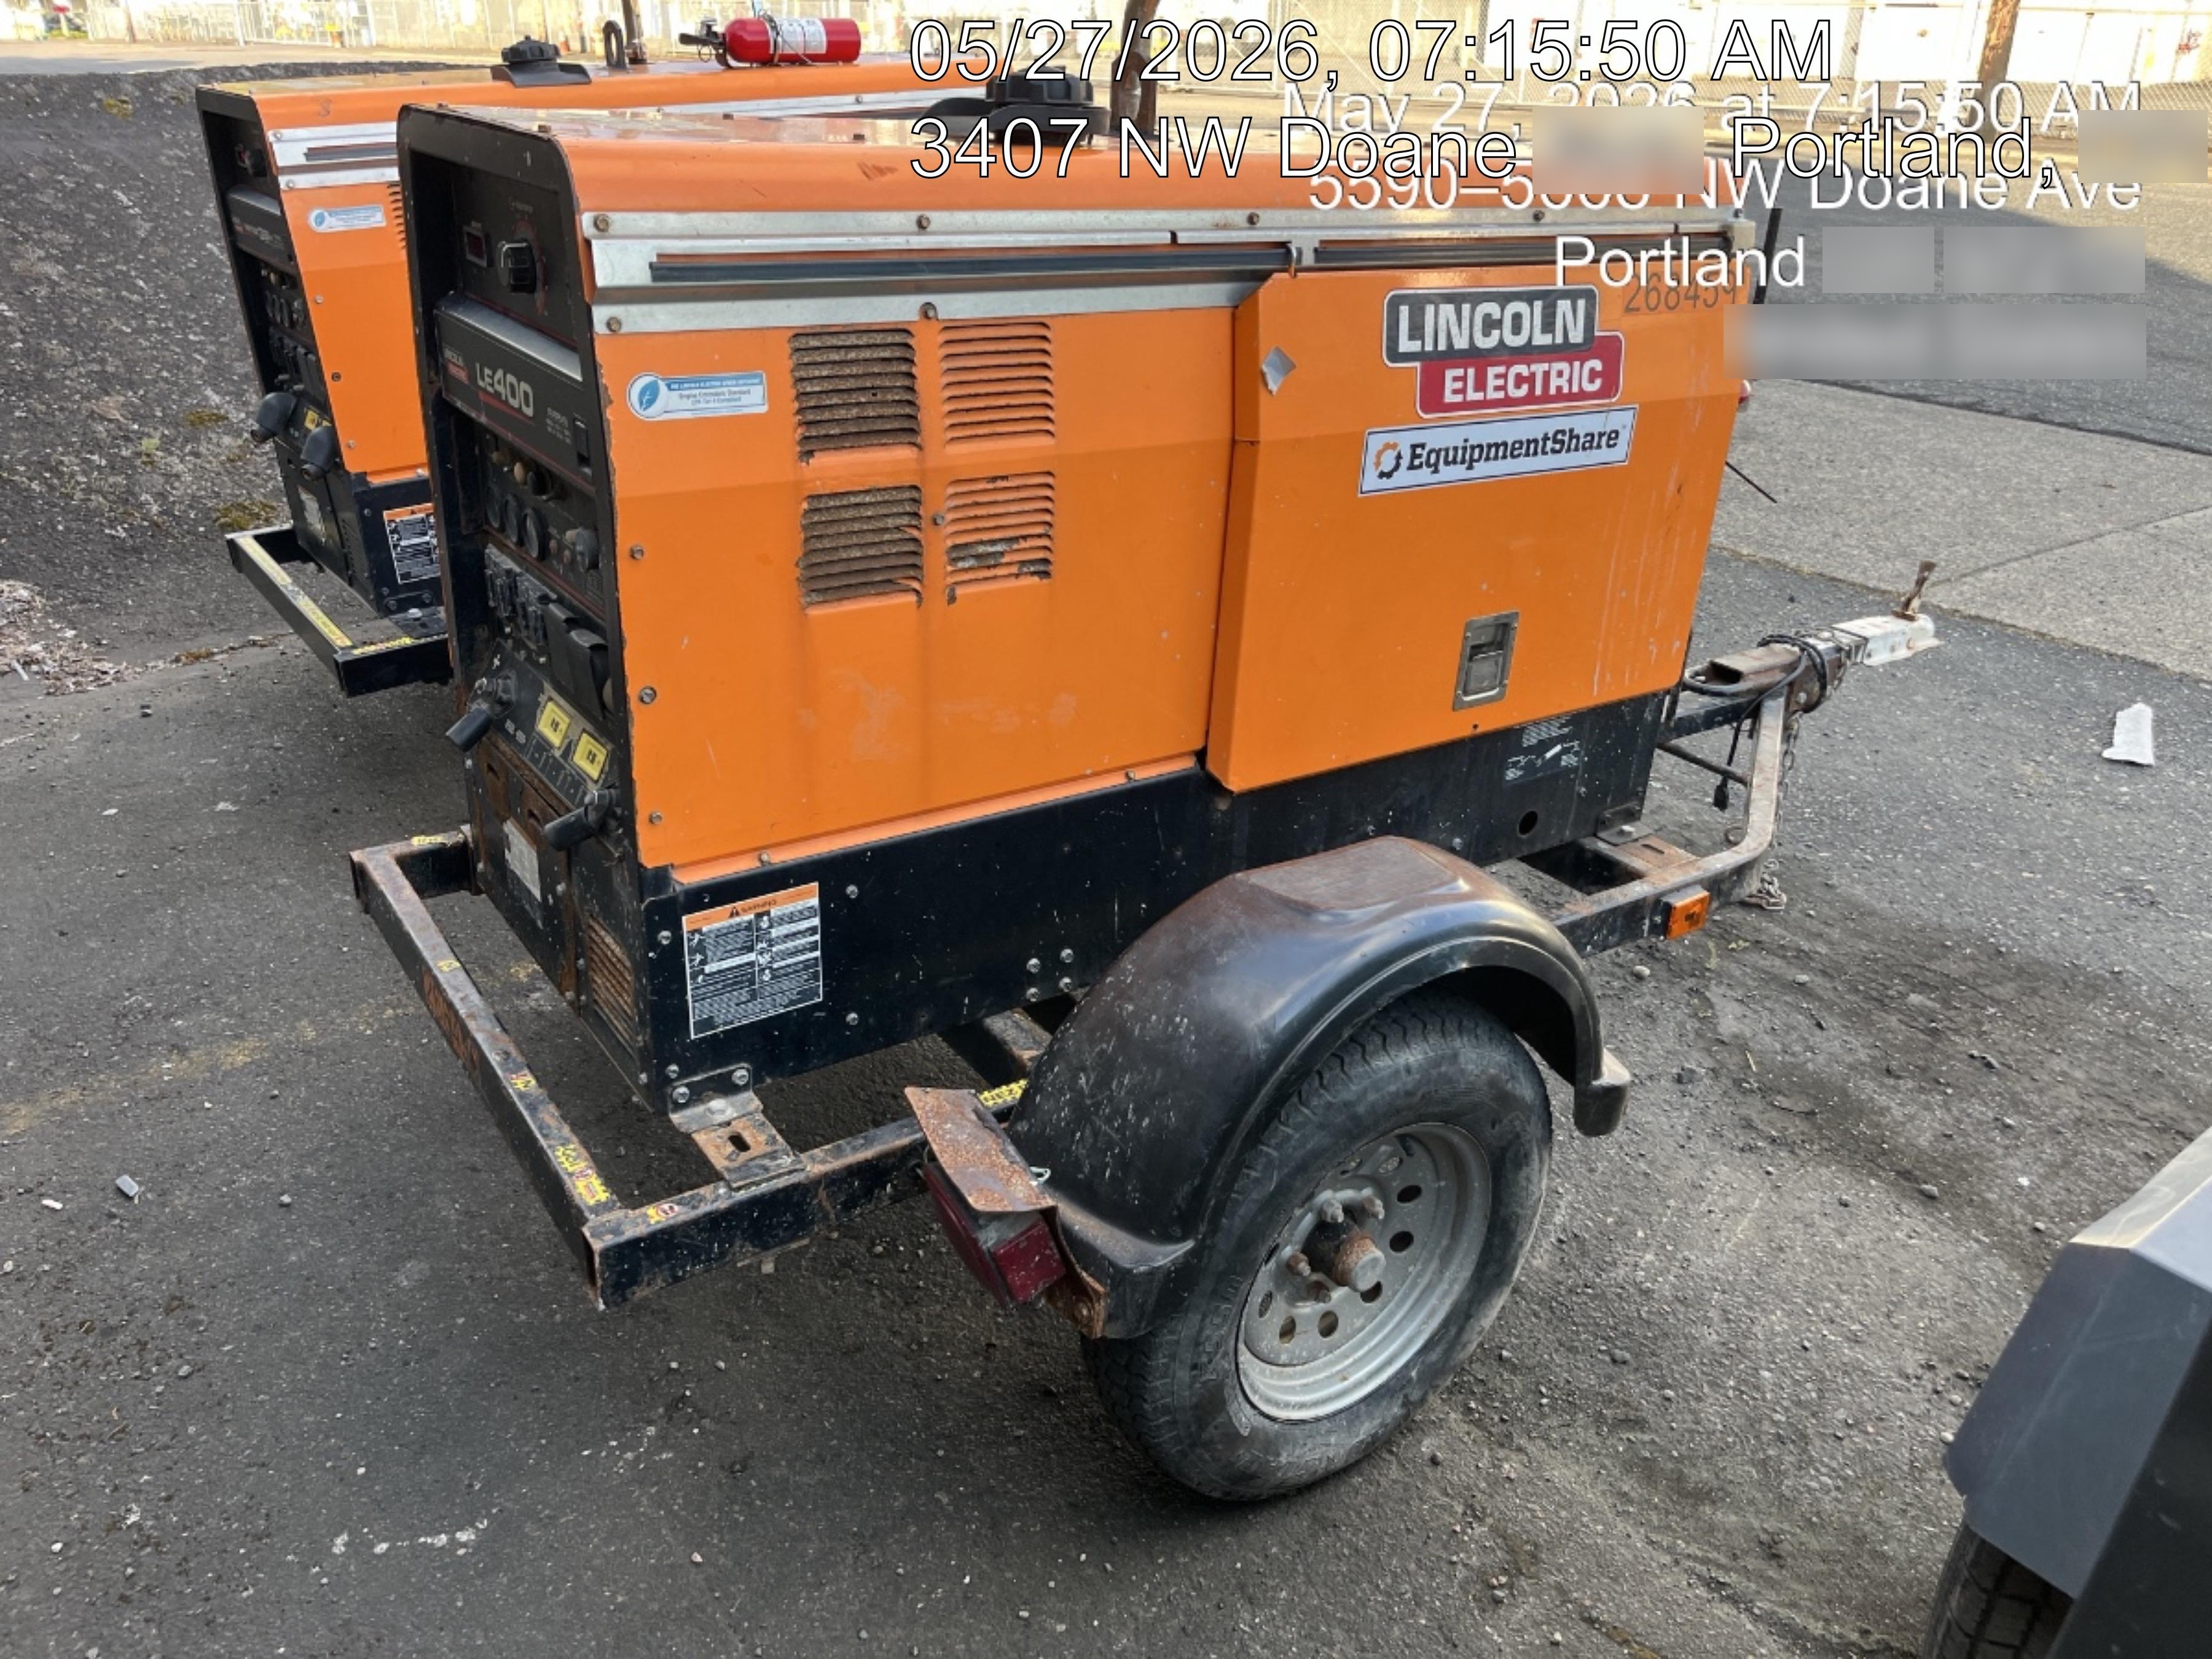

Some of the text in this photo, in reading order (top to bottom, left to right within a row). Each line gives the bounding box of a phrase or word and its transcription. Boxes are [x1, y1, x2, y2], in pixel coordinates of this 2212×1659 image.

[1397, 297, 1585, 354] LINCOLN
[475, 362, 534, 418] LE400
[1443, 358, 1603, 404] ELECTRIC
[1406, 427, 1620, 475] EquipmentShare
